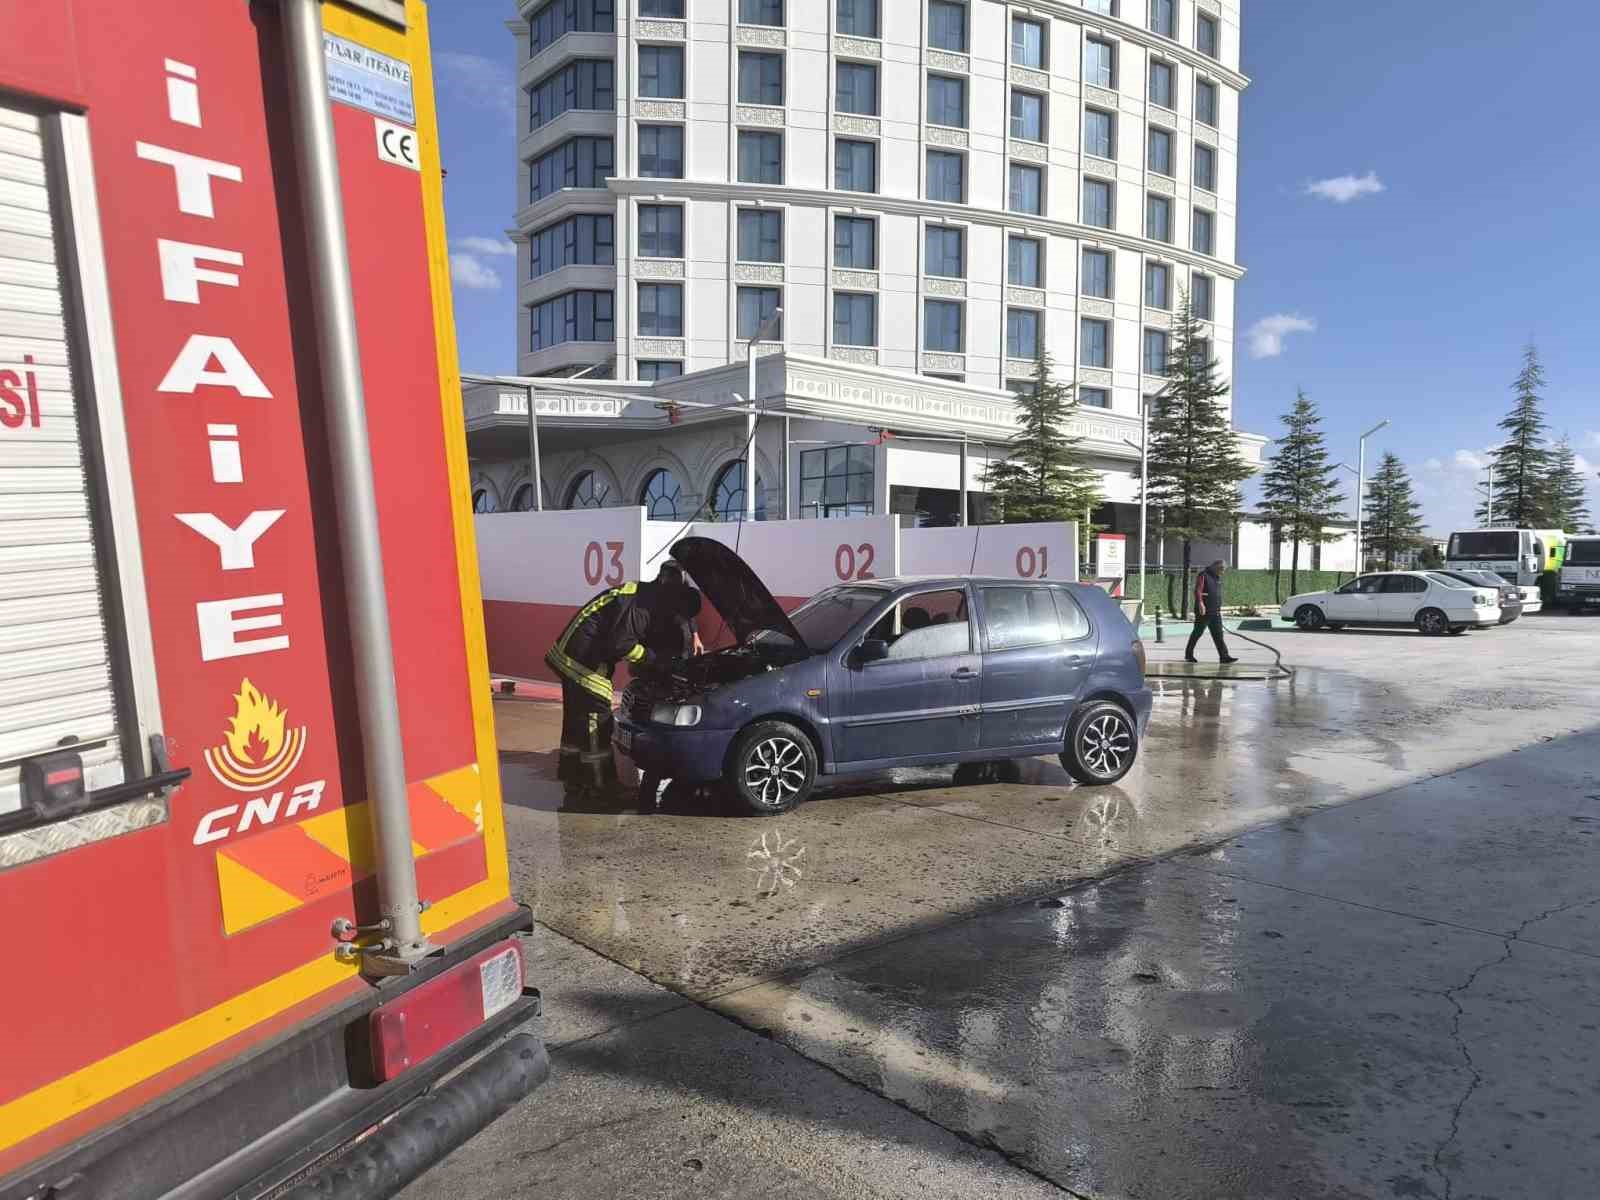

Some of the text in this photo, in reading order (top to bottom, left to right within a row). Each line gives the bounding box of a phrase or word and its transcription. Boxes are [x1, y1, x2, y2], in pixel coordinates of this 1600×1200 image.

[383, 129, 413, 163] CE
[584, 541, 624, 586] 03
[835, 543, 875, 581] 02
[1016, 546, 1048, 578] 01
